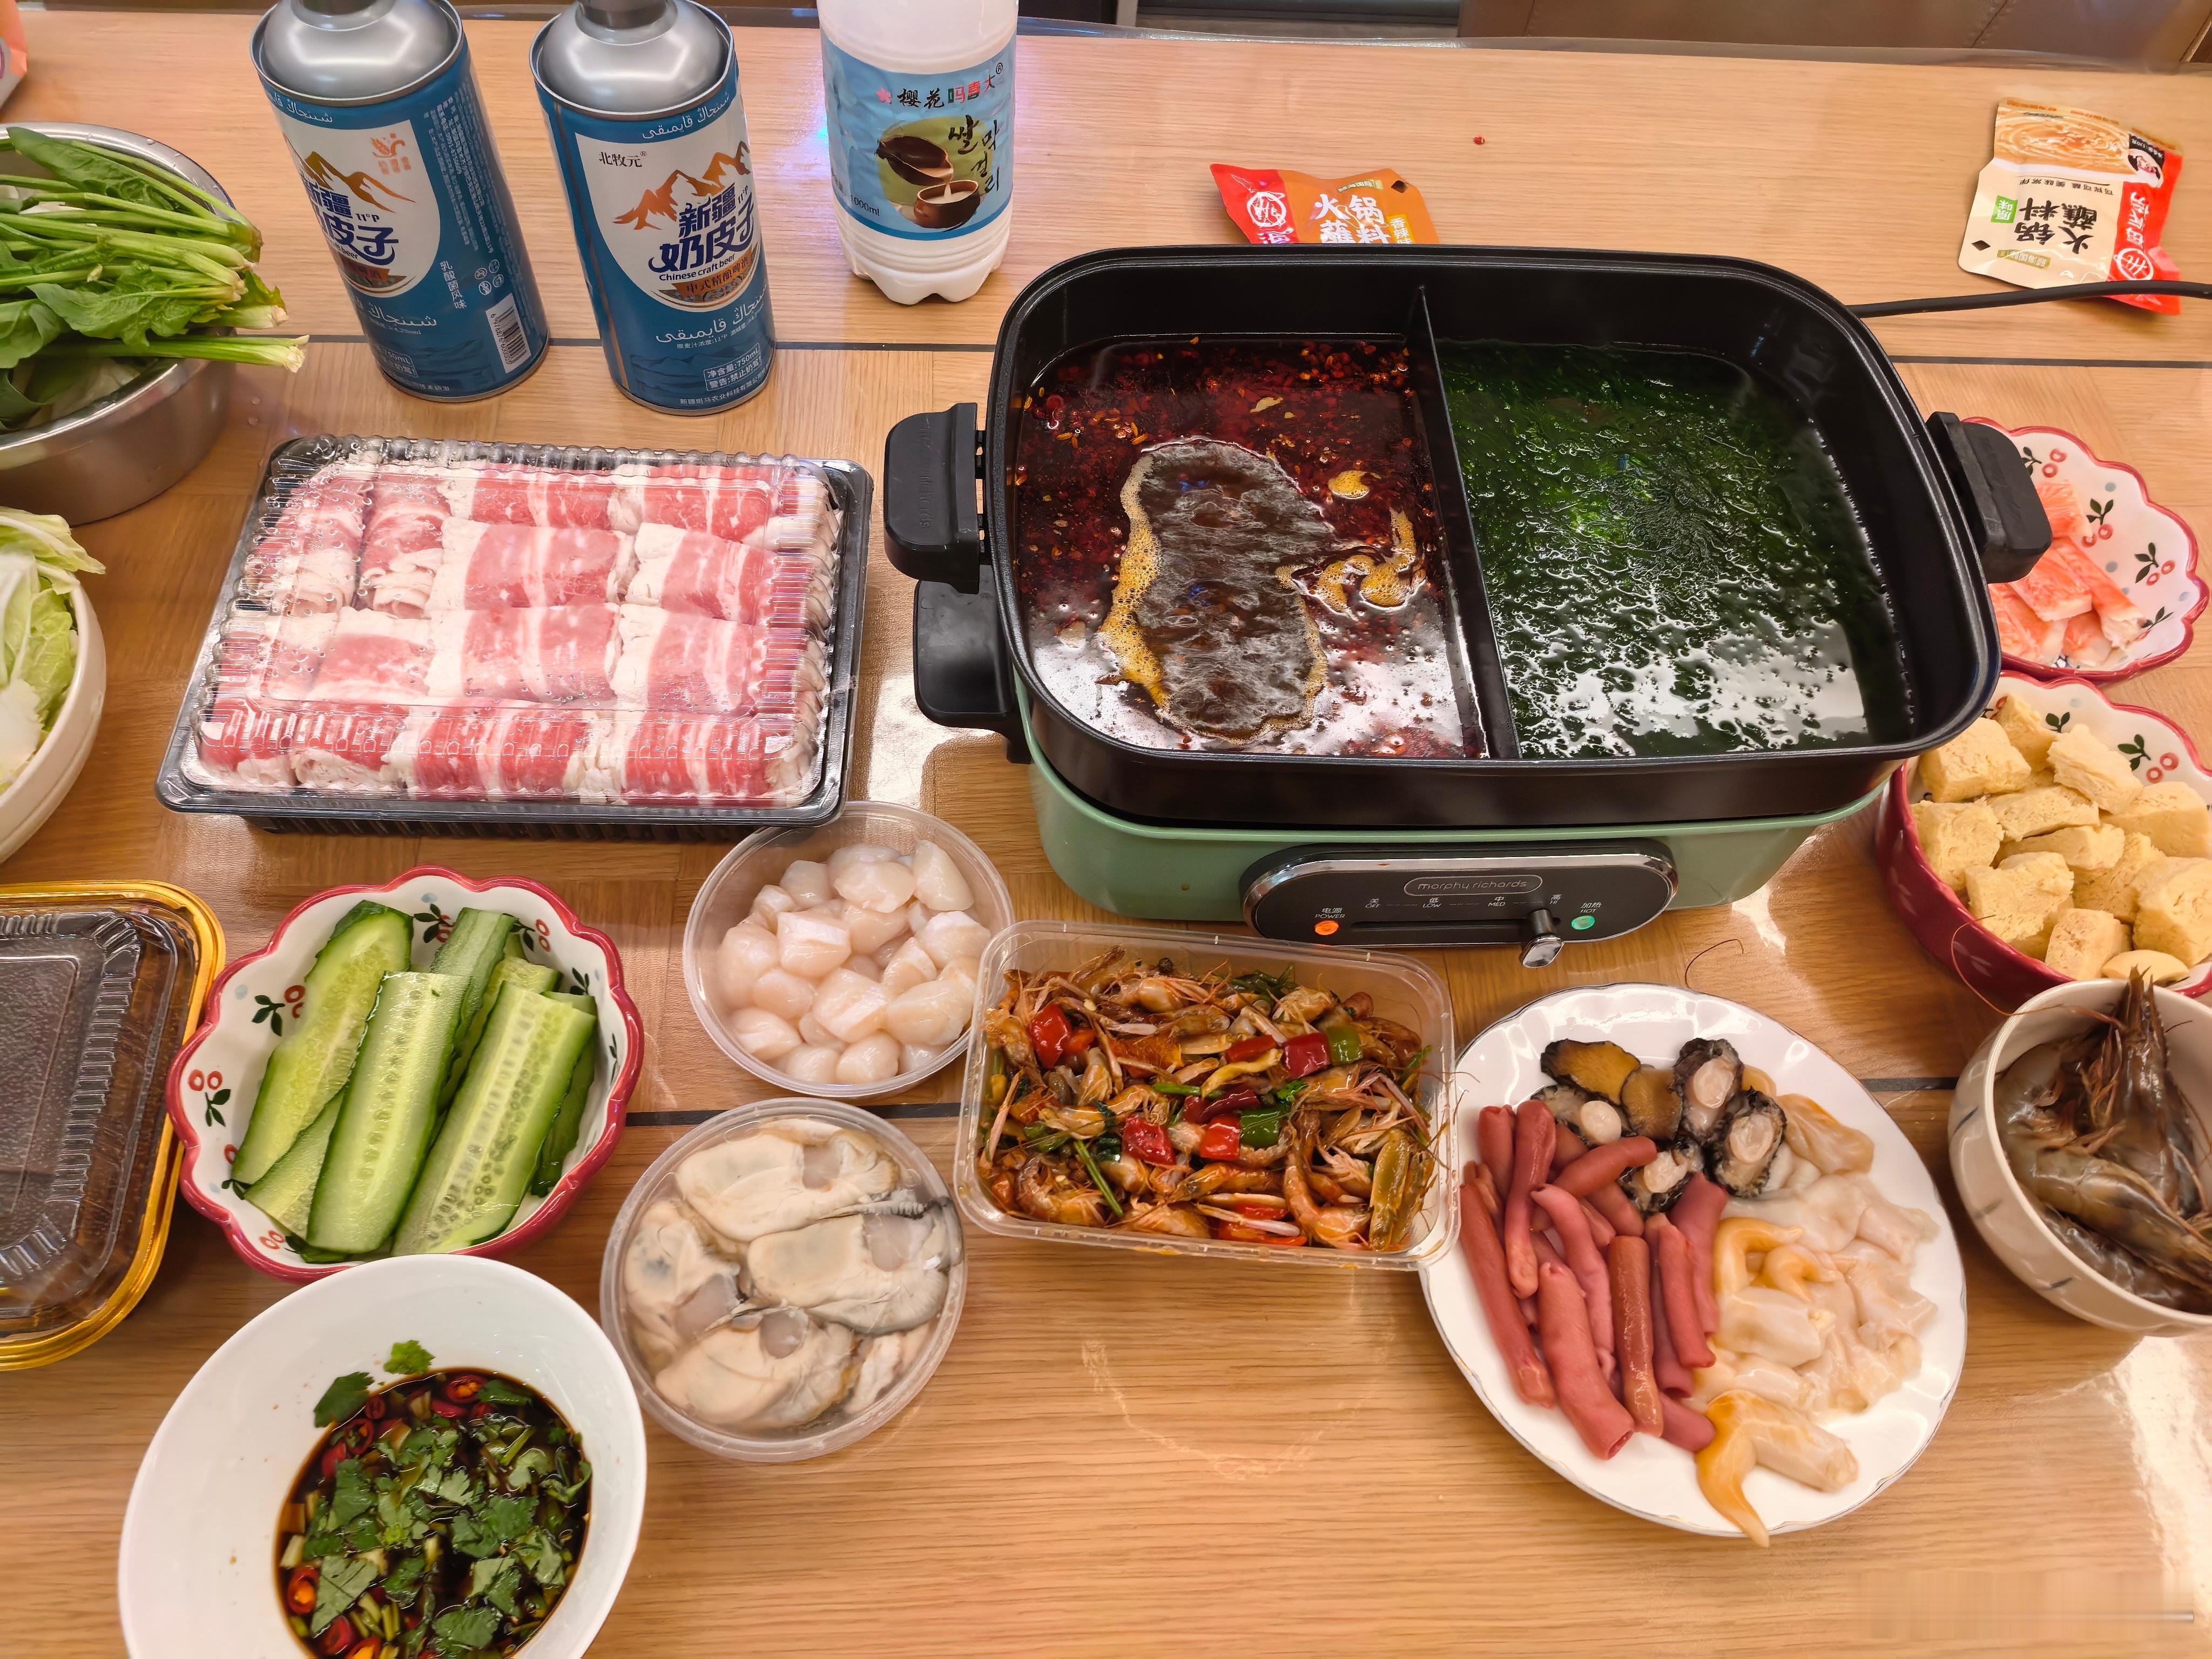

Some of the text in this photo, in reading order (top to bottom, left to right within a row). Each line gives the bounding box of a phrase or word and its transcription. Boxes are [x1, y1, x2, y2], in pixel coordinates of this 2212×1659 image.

[599, 151, 642, 167] 北牧元
[678, 181, 736, 238] 新疆
[1313, 193, 1385, 224] 火锅
[1995, 199, 2013, 221] 原味
[2019, 197, 2097, 231] 蘸料
[649, 192, 754, 273] 奶皮子
[2014, 221, 2094, 254] 火锅
[659, 253, 735, 281] Chinese craft beer
[440, 261, 467, 309] 乳酸菌风味
[1418, 880, 1527, 891] morphy richards
